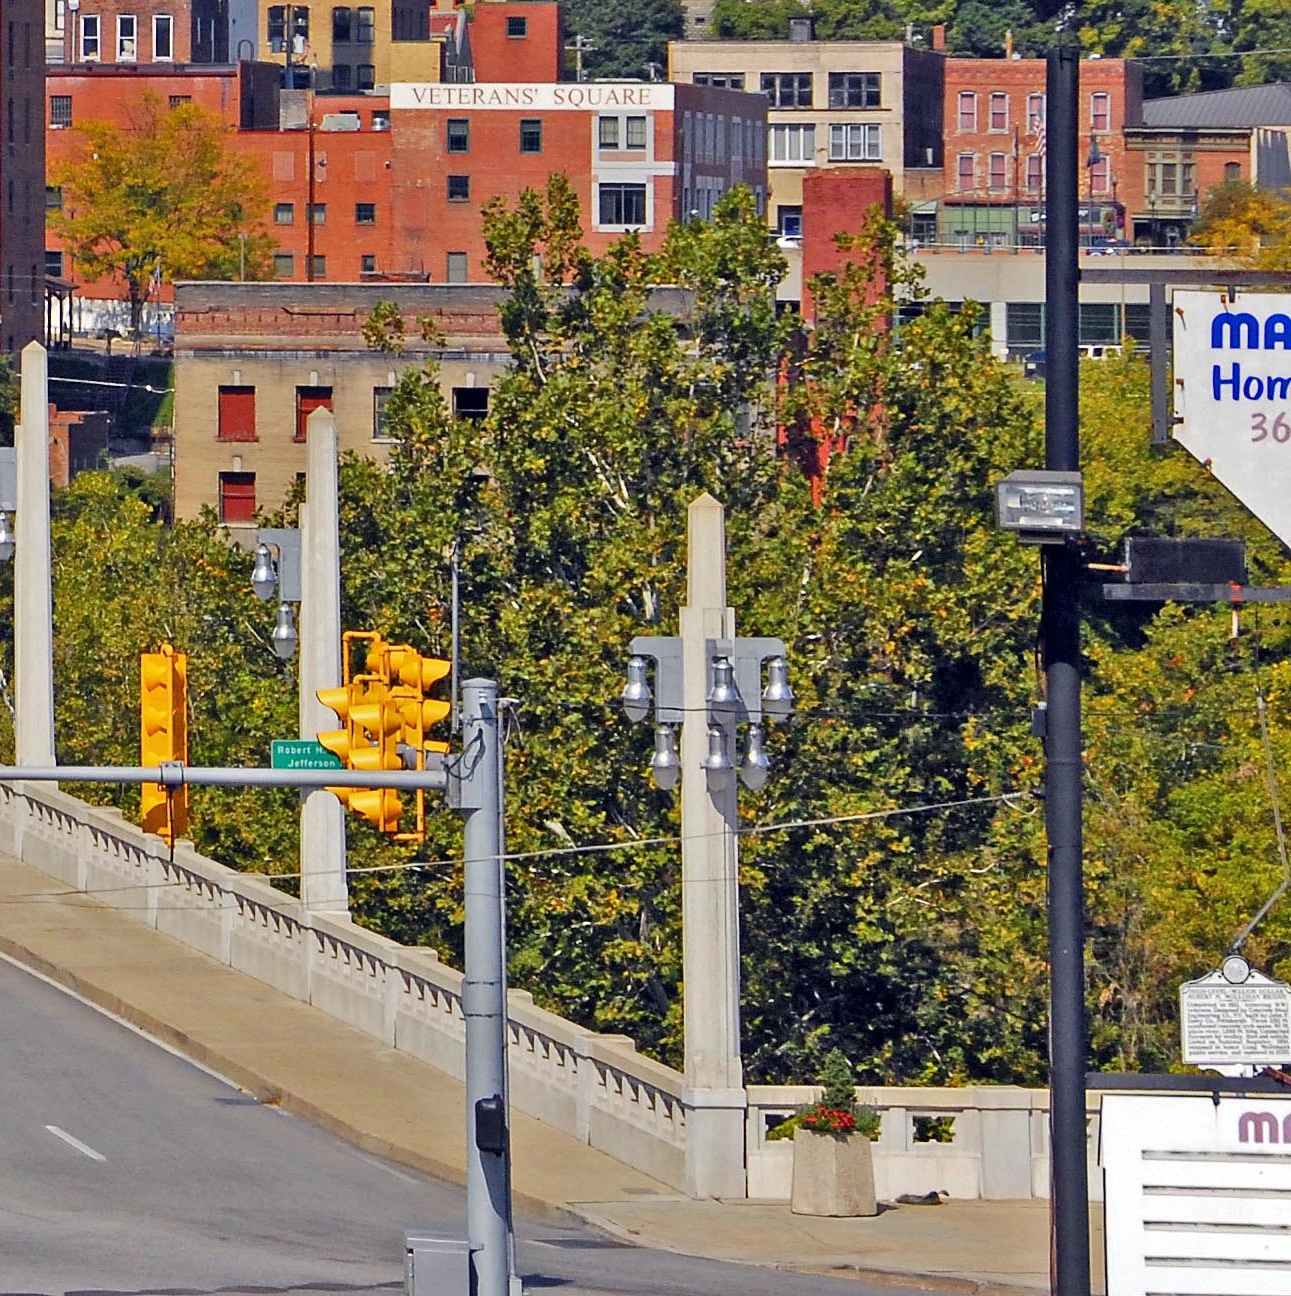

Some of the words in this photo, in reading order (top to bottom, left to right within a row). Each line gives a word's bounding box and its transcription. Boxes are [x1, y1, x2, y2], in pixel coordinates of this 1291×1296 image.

[412, 87, 539, 105] VETERANS'
[554, 87, 652, 108] SQUARE
[277, 746, 311, 755] Robert
[287, 758, 336, 768] Jefferson
